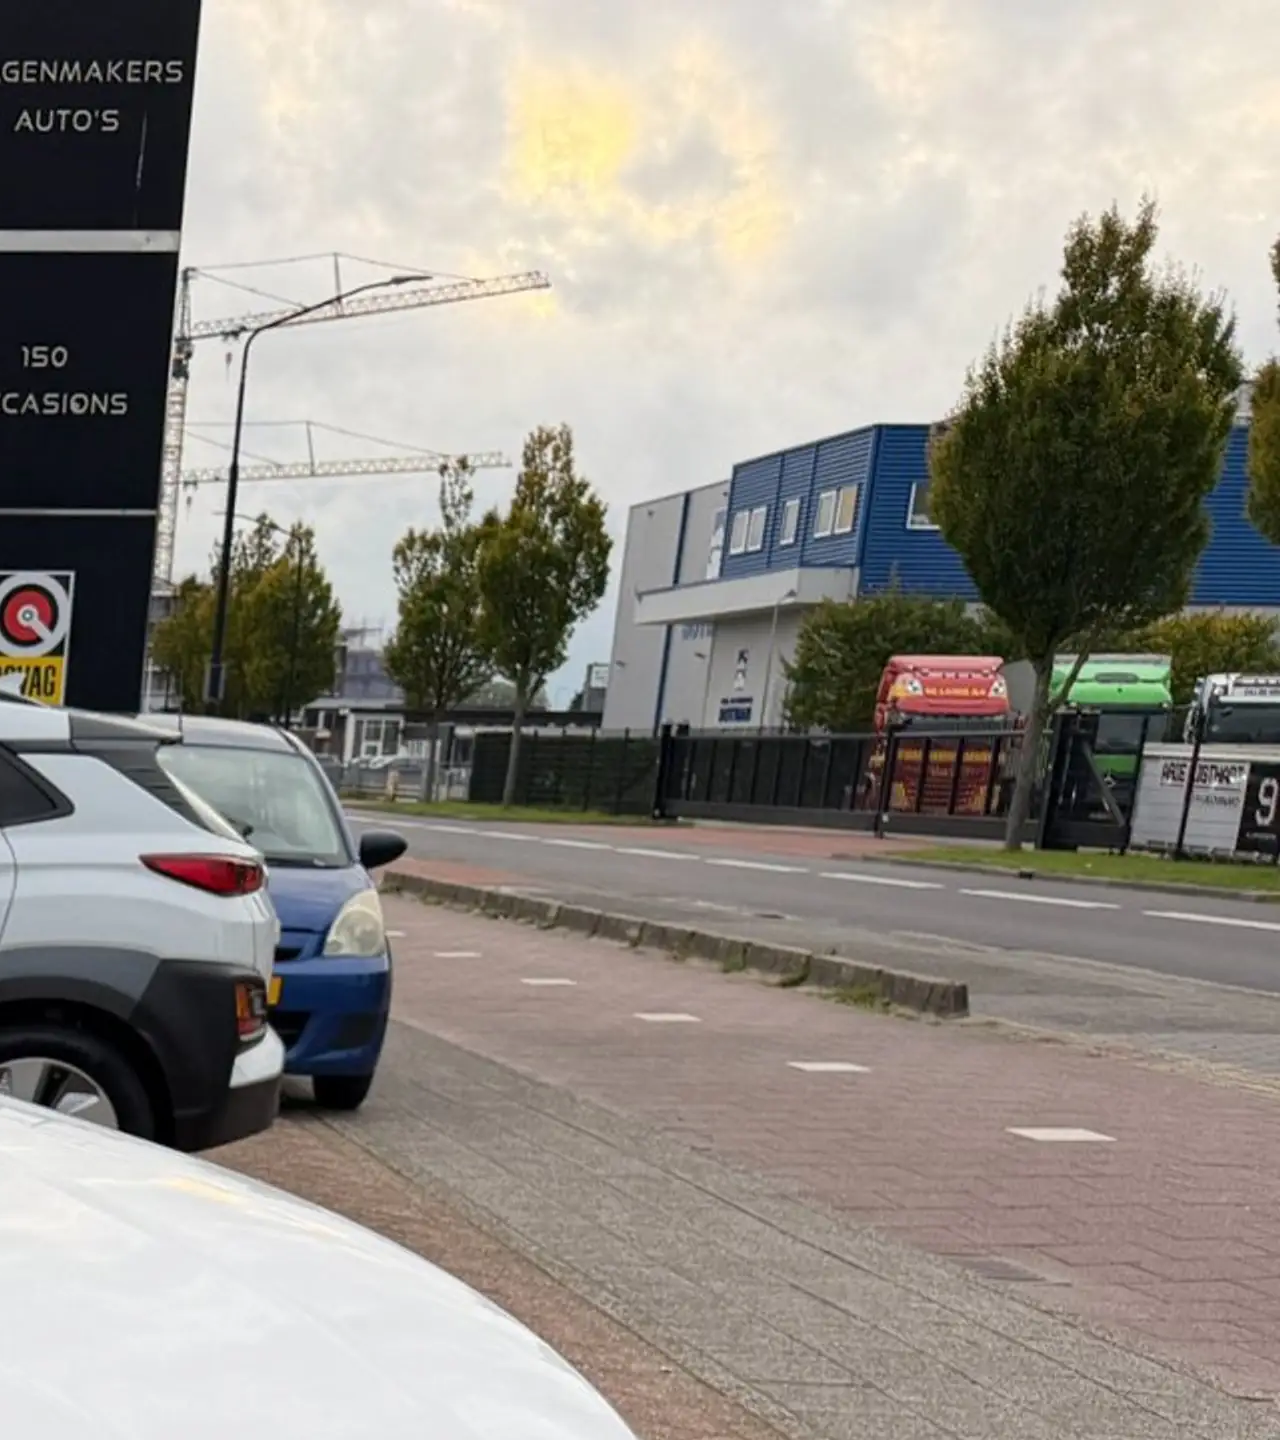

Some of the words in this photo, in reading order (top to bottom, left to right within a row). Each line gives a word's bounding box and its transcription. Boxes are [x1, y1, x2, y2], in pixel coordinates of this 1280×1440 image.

[14, 108, 120, 132] AUTO'S
[21, 345, 69, 368] 150
[1256, 777, 1278, 826] 9
